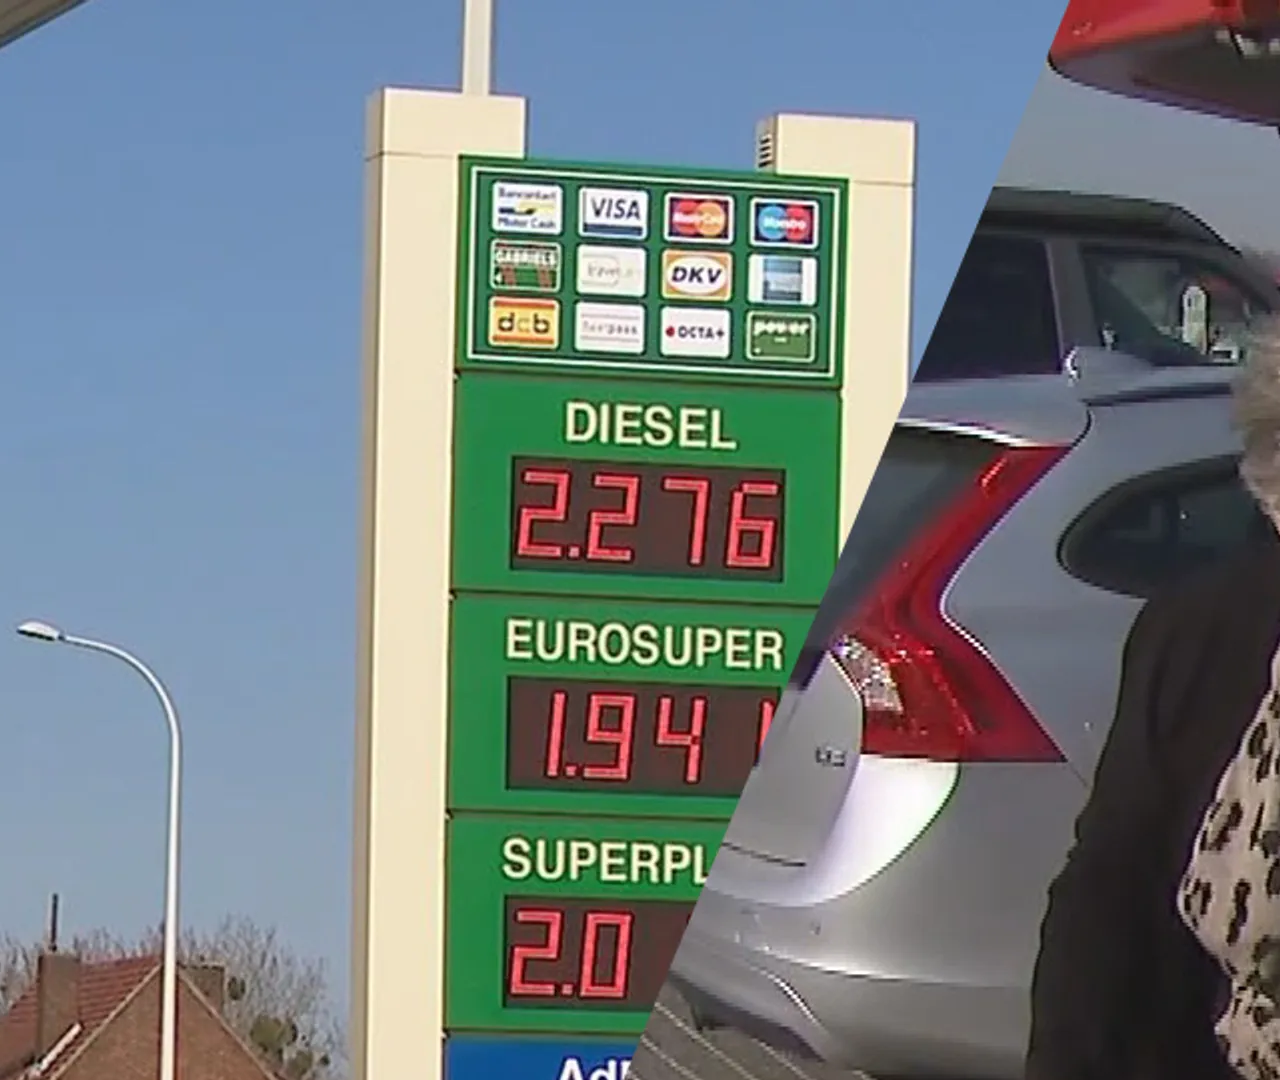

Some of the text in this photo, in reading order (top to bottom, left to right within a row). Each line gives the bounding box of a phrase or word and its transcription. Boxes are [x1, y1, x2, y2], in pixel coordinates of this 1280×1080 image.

[591, 197, 641, 220] VISA
[671, 266, 723, 284] DKV
[564, 400, 737, 450] DIESEL
[516, 470, 781, 568] 2.276
[505, 618, 784, 670] EUROSUPER
